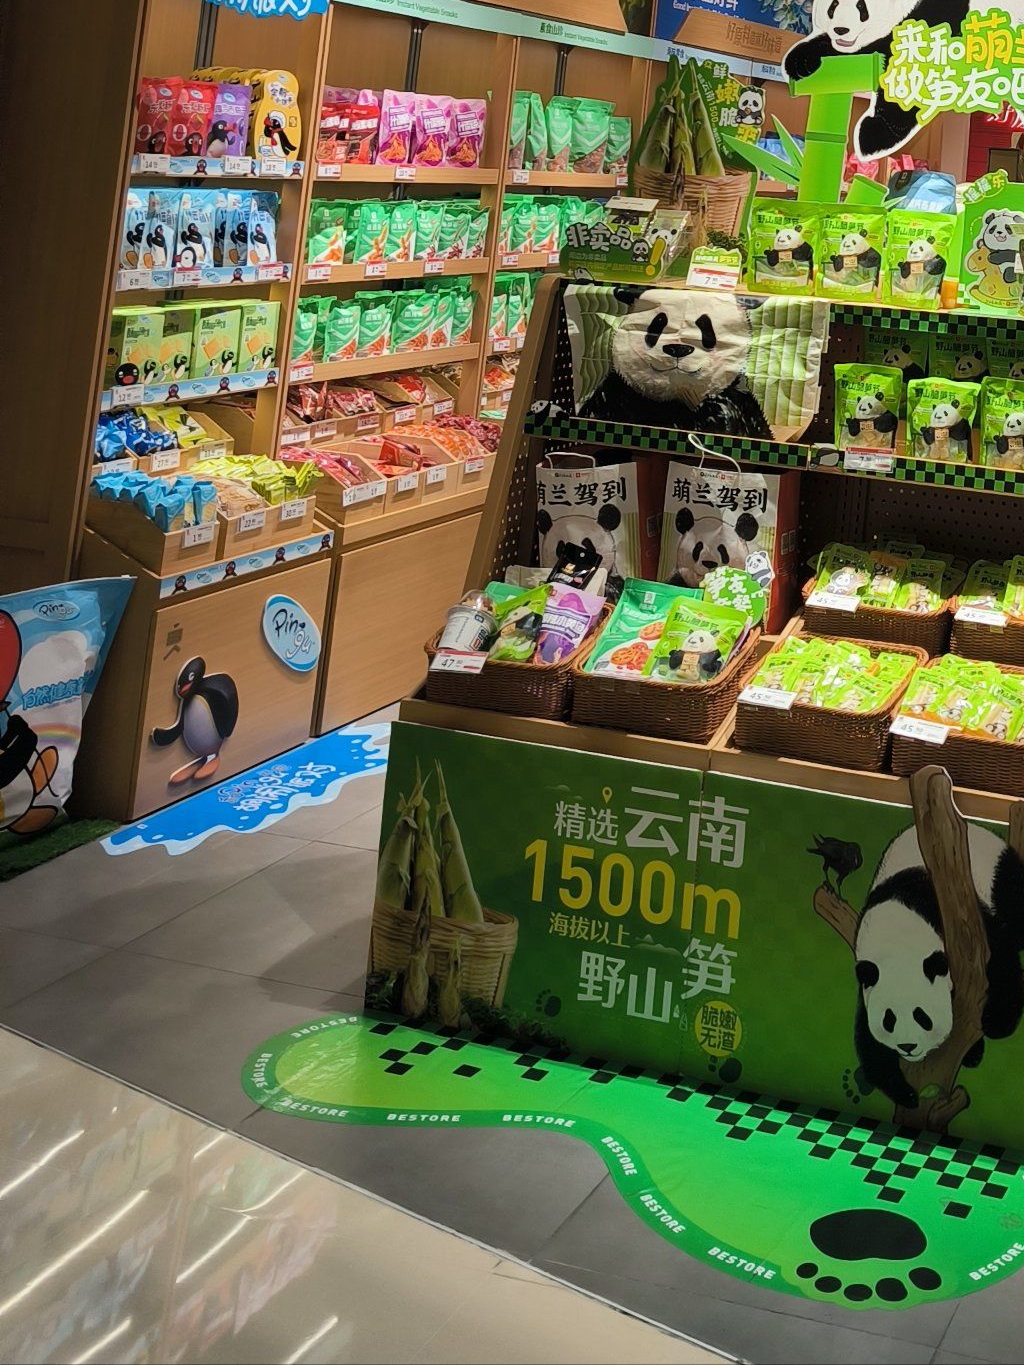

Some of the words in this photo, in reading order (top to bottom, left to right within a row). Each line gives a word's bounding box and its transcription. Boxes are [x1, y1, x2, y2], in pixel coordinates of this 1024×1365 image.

[671, 477, 768, 514] 萌兰驾到
[523, 838, 742, 940] 1500m
[548, 911, 631, 949] 海拔以上
[576, 937, 738, 1025] 野山笋
[699, 1003, 737, 1030] 脆嫩
[699, 1026, 738, 1053] 无渣
[386, 1112, 462, 1123] BESTORE
[501, 1114, 577, 1129] BESTORE
[600, 1135, 638, 1177] BESTORE
[638, 1193, 687, 1236] BESTORE
[707, 1246, 777, 1281] BESTORE
